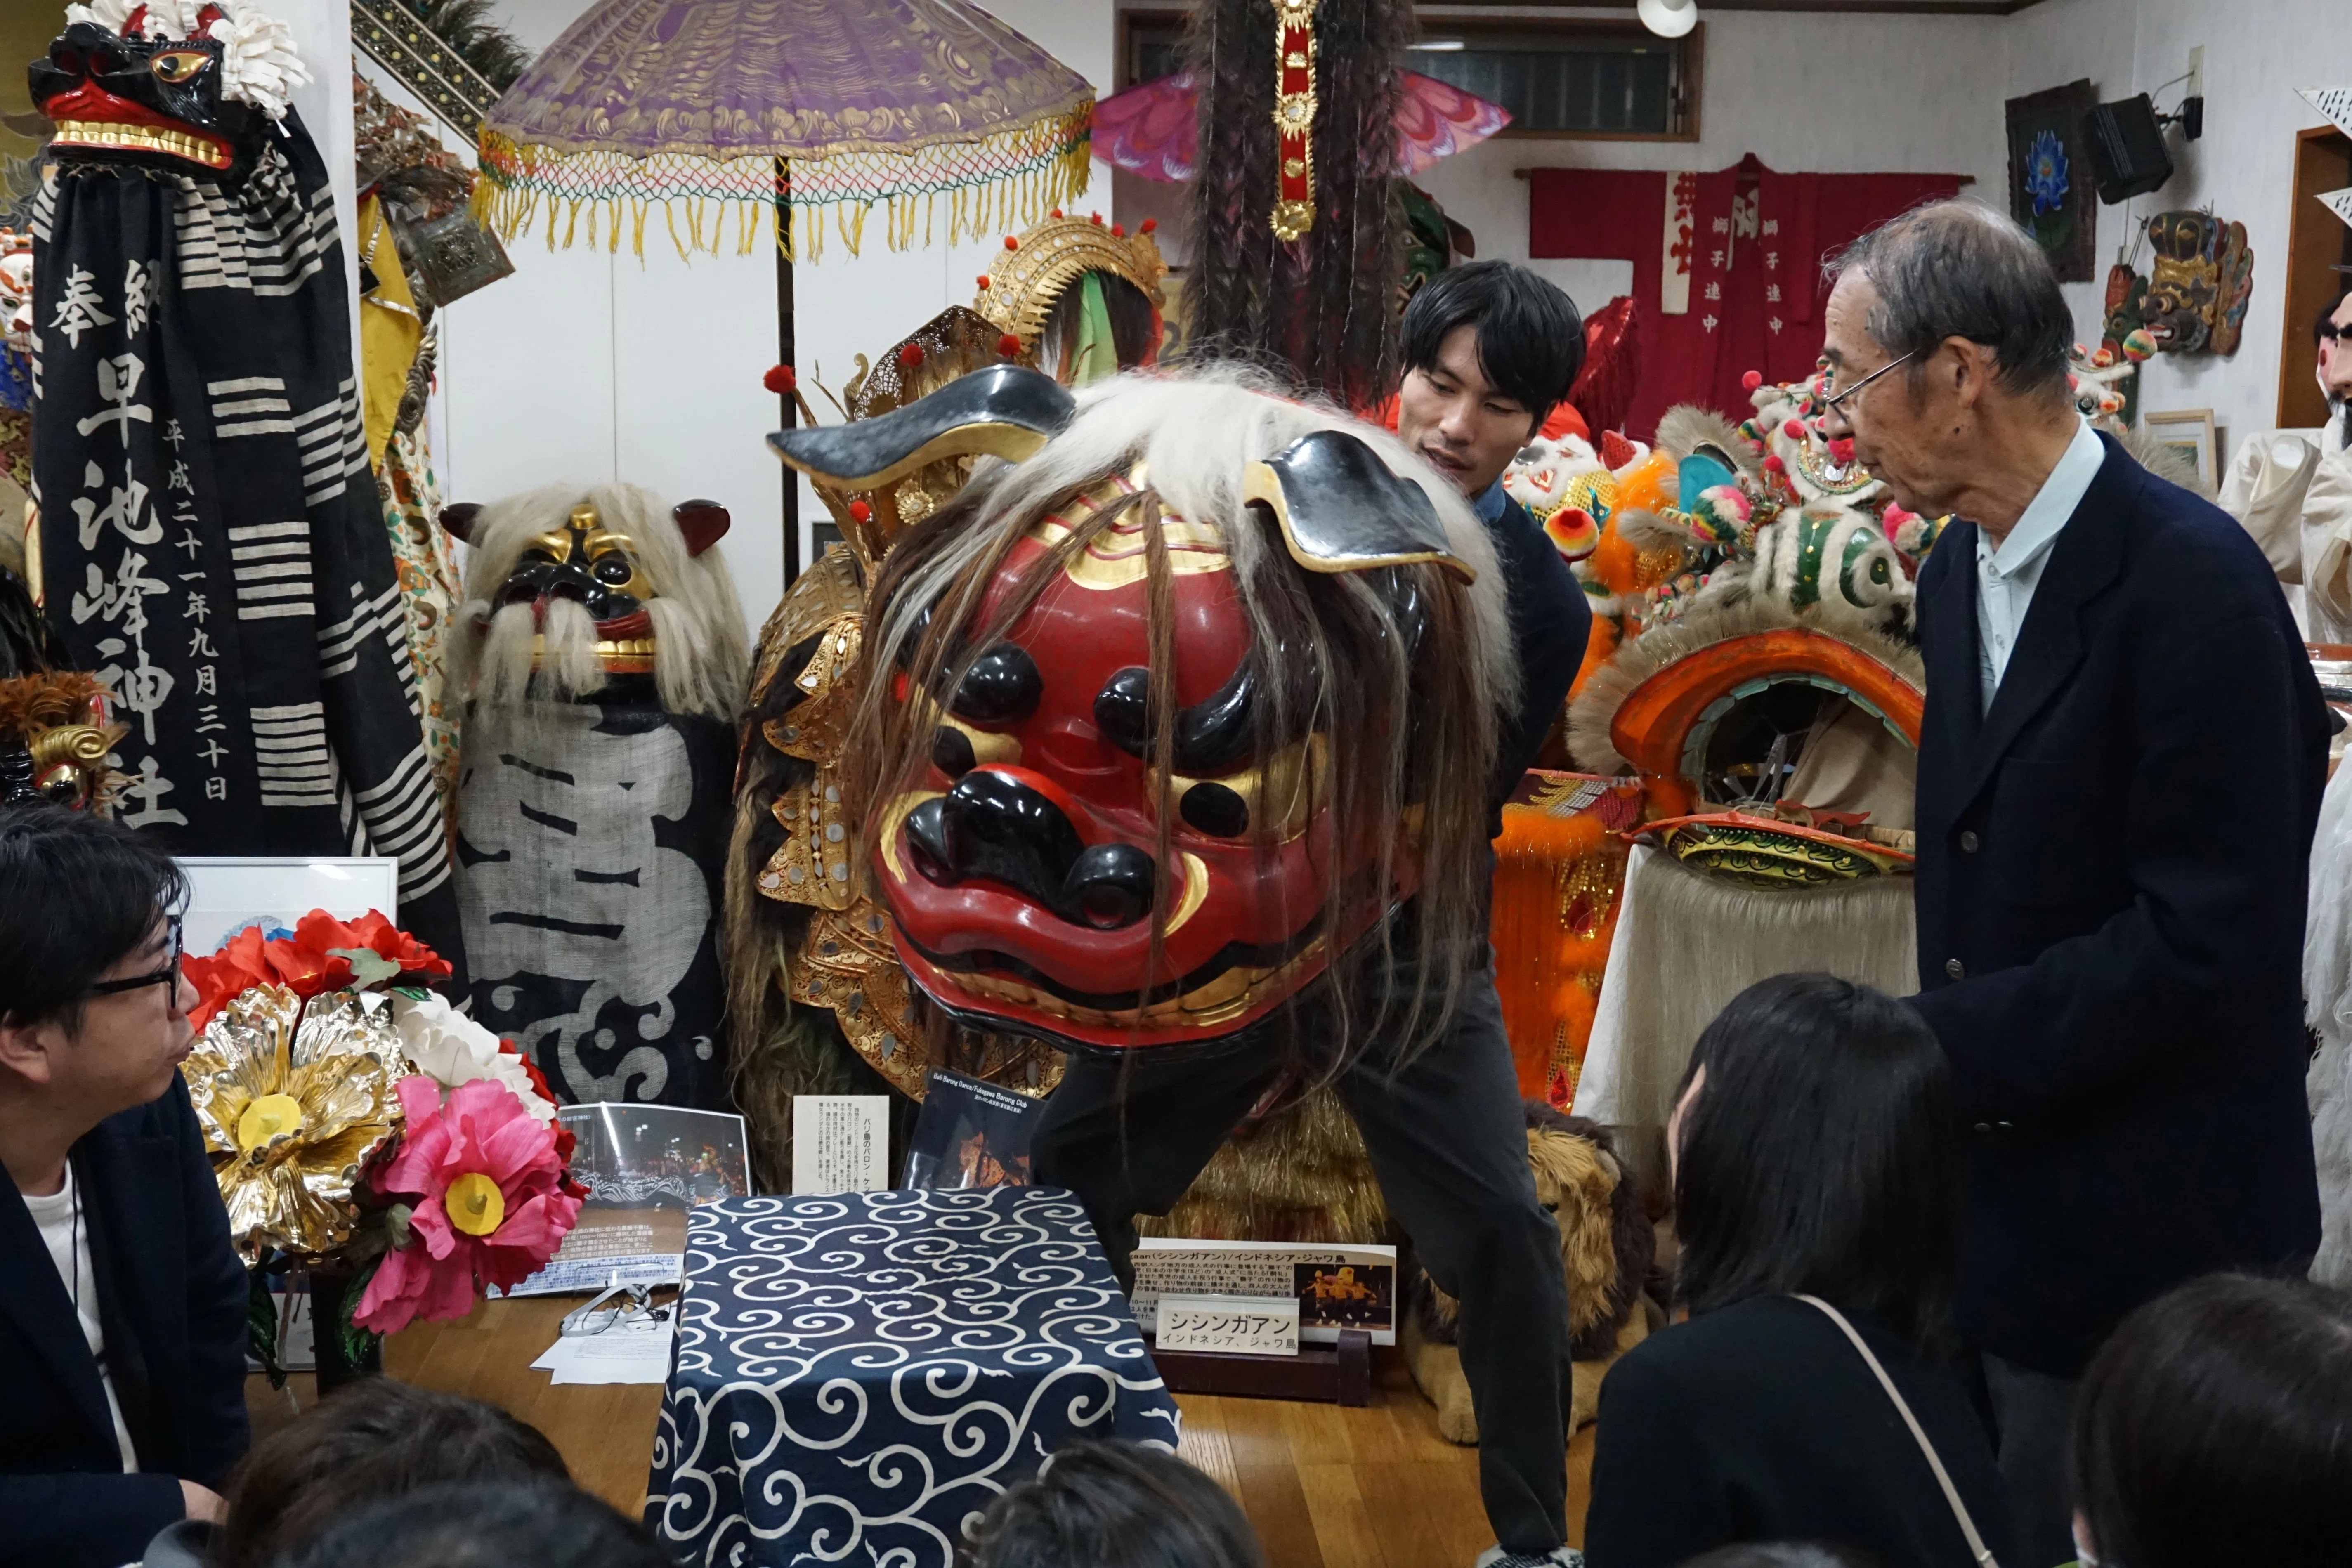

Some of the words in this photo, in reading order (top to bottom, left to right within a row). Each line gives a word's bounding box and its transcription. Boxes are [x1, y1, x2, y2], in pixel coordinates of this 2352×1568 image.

[1702, 216, 1729, 334] 獅子連中
[1763, 219, 1783, 335] 獅子連中
[71, 352, 188, 830] 早池峰神社
[163, 419, 227, 800] 平成二十一年九月三十日
[933, 1072, 942, 1081] Bali
[943, 1075, 958, 1087] Barong
[996, 1092, 1015, 1105] Barong
[1016, 1099, 1027, 1108] Club
[863, 1118, 871, 1192] バリ島のバロン・ケッ
[1162, 1334, 1296, 1351] インドネシア、ジャワ島
[1171, 1313, 1290, 1334] シシンガアン
